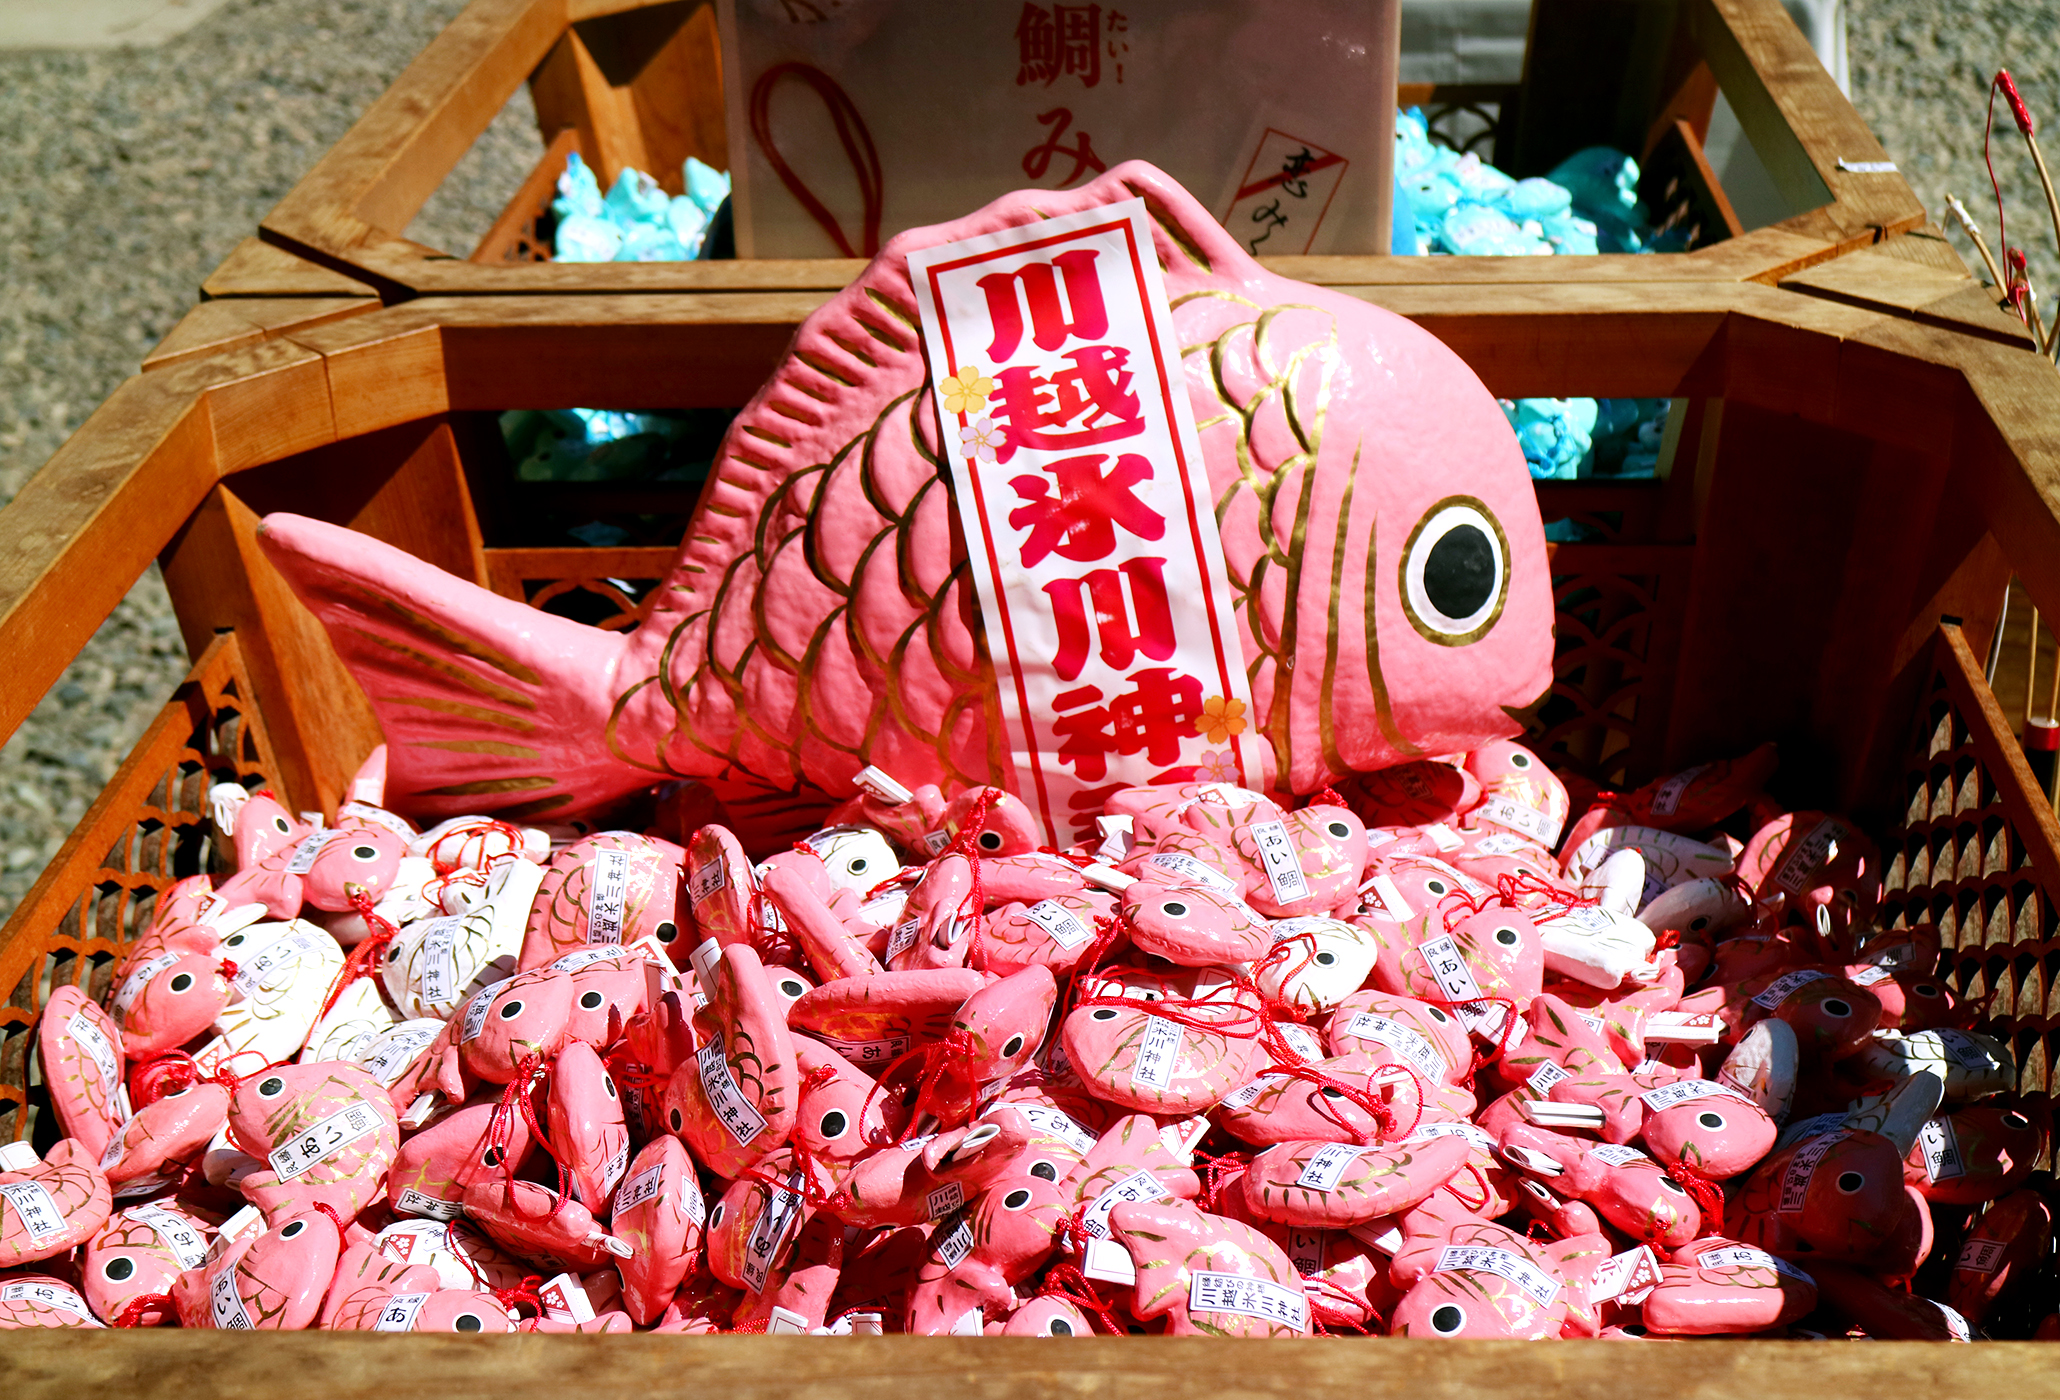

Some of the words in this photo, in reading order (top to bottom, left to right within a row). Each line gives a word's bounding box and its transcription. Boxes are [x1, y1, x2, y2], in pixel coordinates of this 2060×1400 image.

[1014, 3, 1107, 187] 鯛み
[1266, 835, 1301, 890] あい鯛
[1427, 942, 1451, 958] 良縁
[703, 1046, 754, 1137] 川越氷川神社
[300, 1109, 368, 1159] あい鯛
[754, 1189, 800, 1258] あい鯛
[1201, 1276, 1266, 1293] 縁結びの神様
[1444, 1253, 1550, 1299] 川越氷川神社
[385, 1307, 406, 1322] あ
[1201, 1288, 1301, 1324] 川越氷川神社
